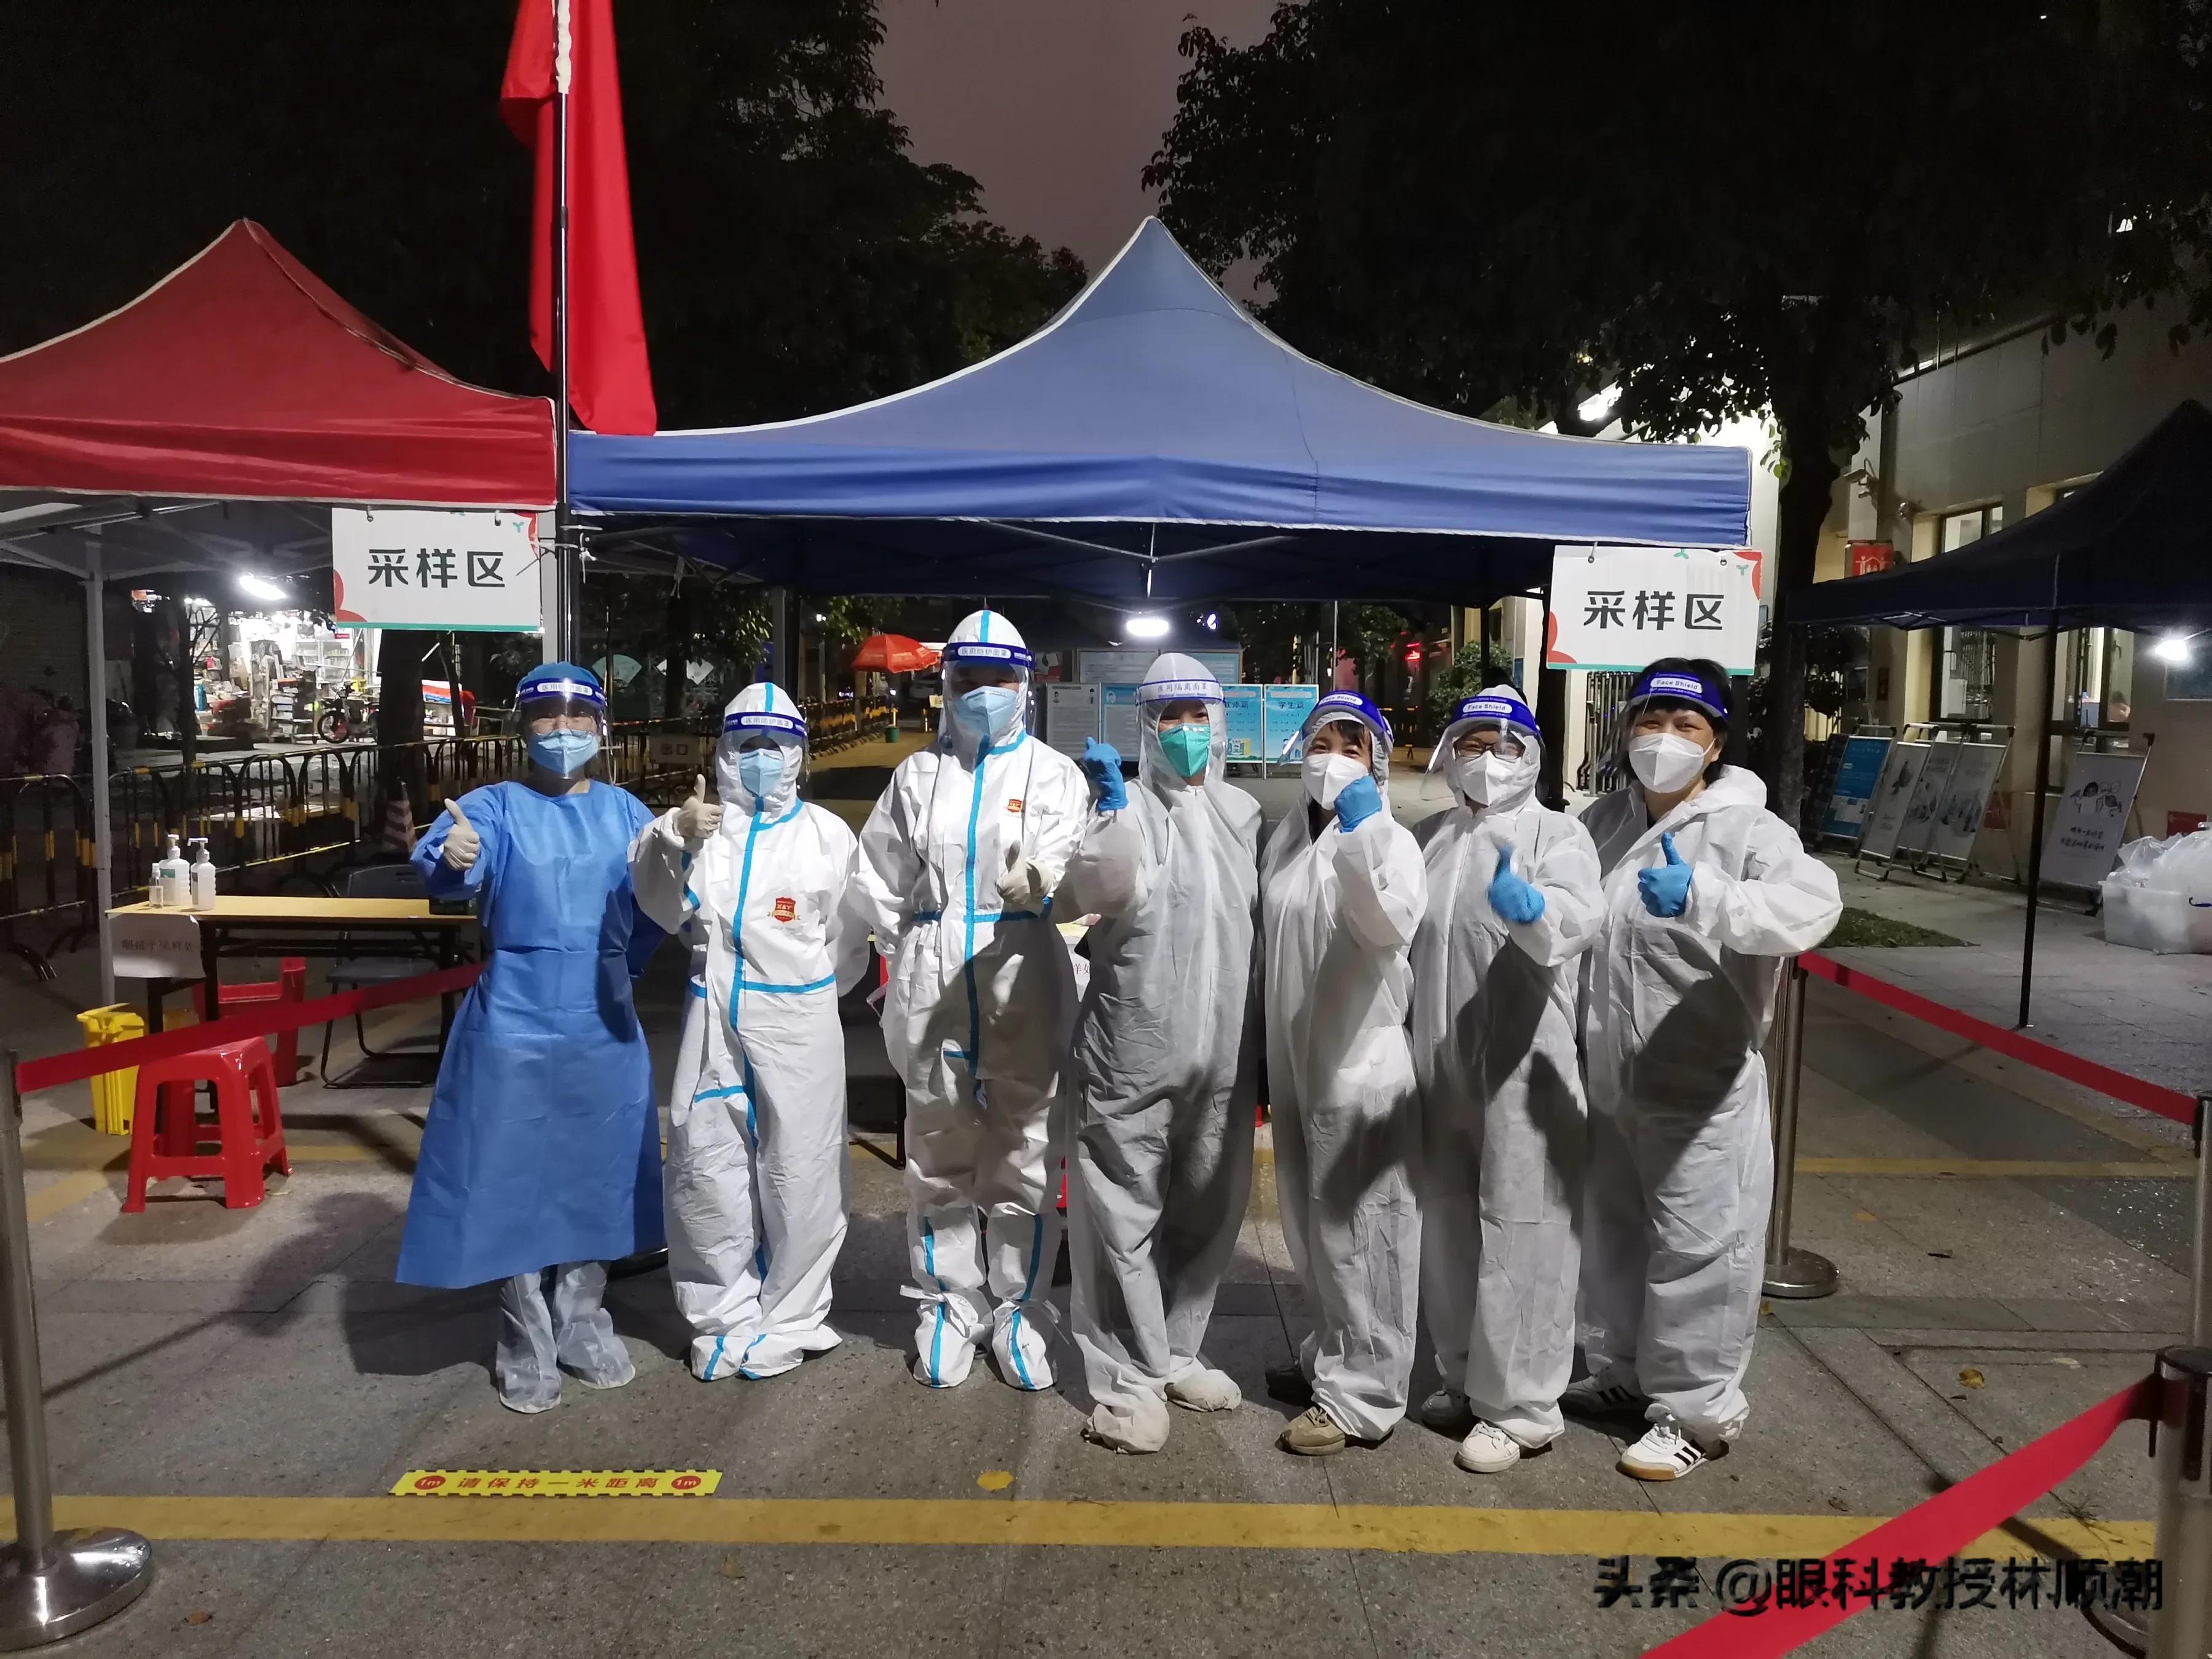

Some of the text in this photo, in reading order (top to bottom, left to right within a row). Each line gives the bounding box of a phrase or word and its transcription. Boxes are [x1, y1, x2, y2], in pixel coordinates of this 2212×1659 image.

[367, 548, 506, 588] 采样区
[1583, 590, 1725, 630] 采样区
[1674, 680, 1698, 689] Shield
[457, 1478, 659, 1489] 请保持一米距离
